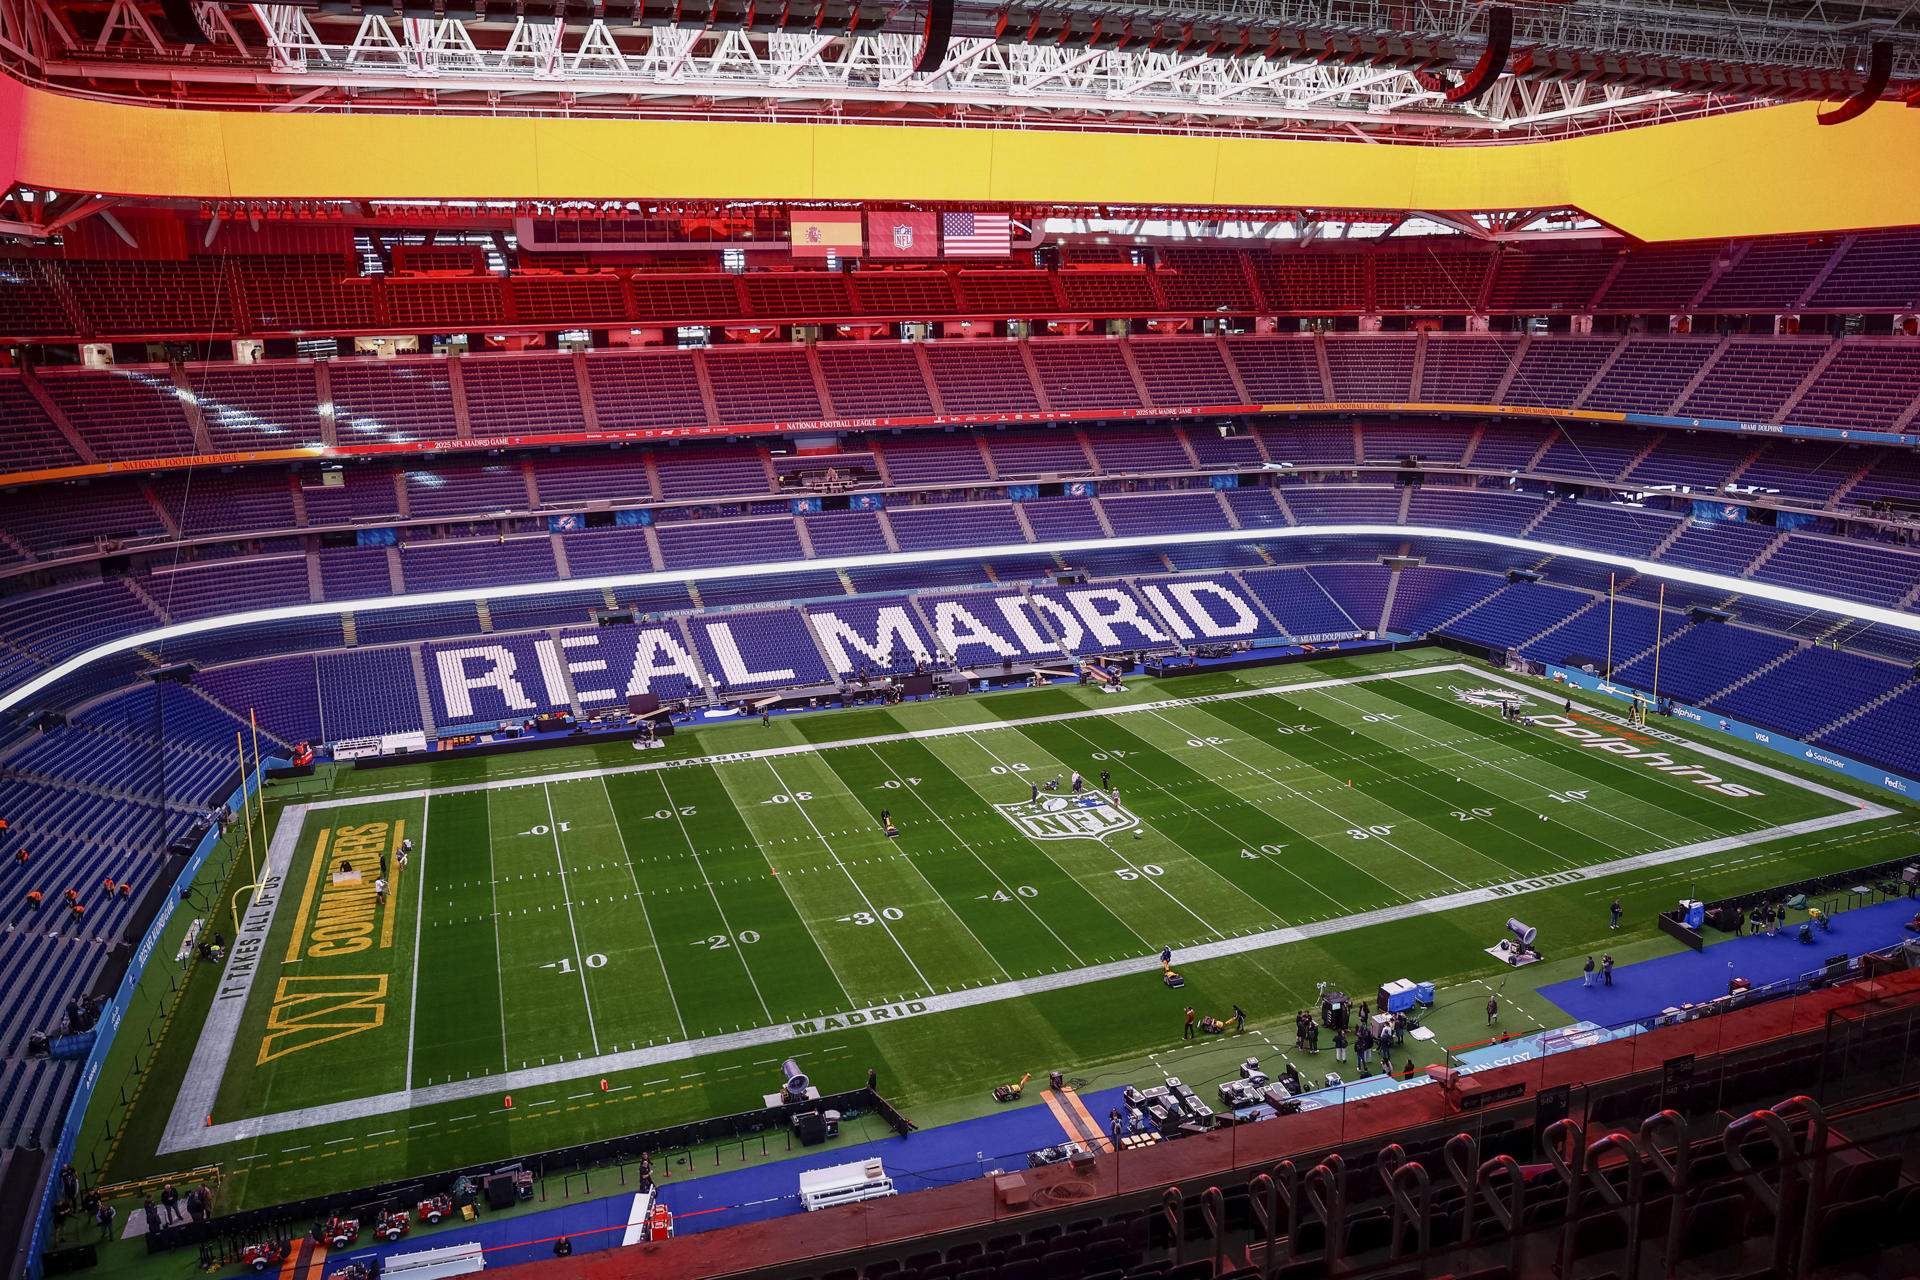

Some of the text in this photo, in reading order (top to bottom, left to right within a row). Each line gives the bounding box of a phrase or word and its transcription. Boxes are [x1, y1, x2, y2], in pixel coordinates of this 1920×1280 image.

[896, 235, 911, 247] NFL
[787, 418, 877, 431] NATIONAL FOOTBALL LEAGUE
[1740, 423, 1784, 433] MIAMI DOLPHINS
[434, 437, 509, 449] 2025 NFL MADRID GAME
[122, 453, 239, 471] NATIONAL FOOTBALL LEAGUE
[1299, 630, 1354, 644] MIAMI DOLPHINS
[436, 581, 1259, 718] REAL MADRID
[1148, 695, 1220, 710] MADRID
[1588, 709, 1620, 722] END
[1671, 706, 1702, 721] olphins
[1754, 732, 1770, 744] VISA
[665, 751, 753, 768] MADRID
[1521, 714, 1767, 798] Dolphins
[1813, 752, 1845, 769] Santander
[989, 762, 1032, 776] 50
[770, 790, 814, 804] 30
[1547, 789, 1587, 804] 10
[654, 805, 698, 820] 20
[1024, 808, 1122, 834] NFL
[1449, 807, 1493, 823] 20
[1345, 824, 1391, 841] 30
[1239, 843, 1283, 861] 40
[1113, 863, 1166, 882] 50
[1488, 870, 1588, 897] MADRID
[991, 885, 1039, 903] 40
[852, 907, 905, 926] 30
[219, 876, 282, 1000] IT TAKES ALL OF US
[706, 930, 761, 950] 20
[555, 953, 609, 975] 10
[791, 1001, 928, 1036] MADRID
